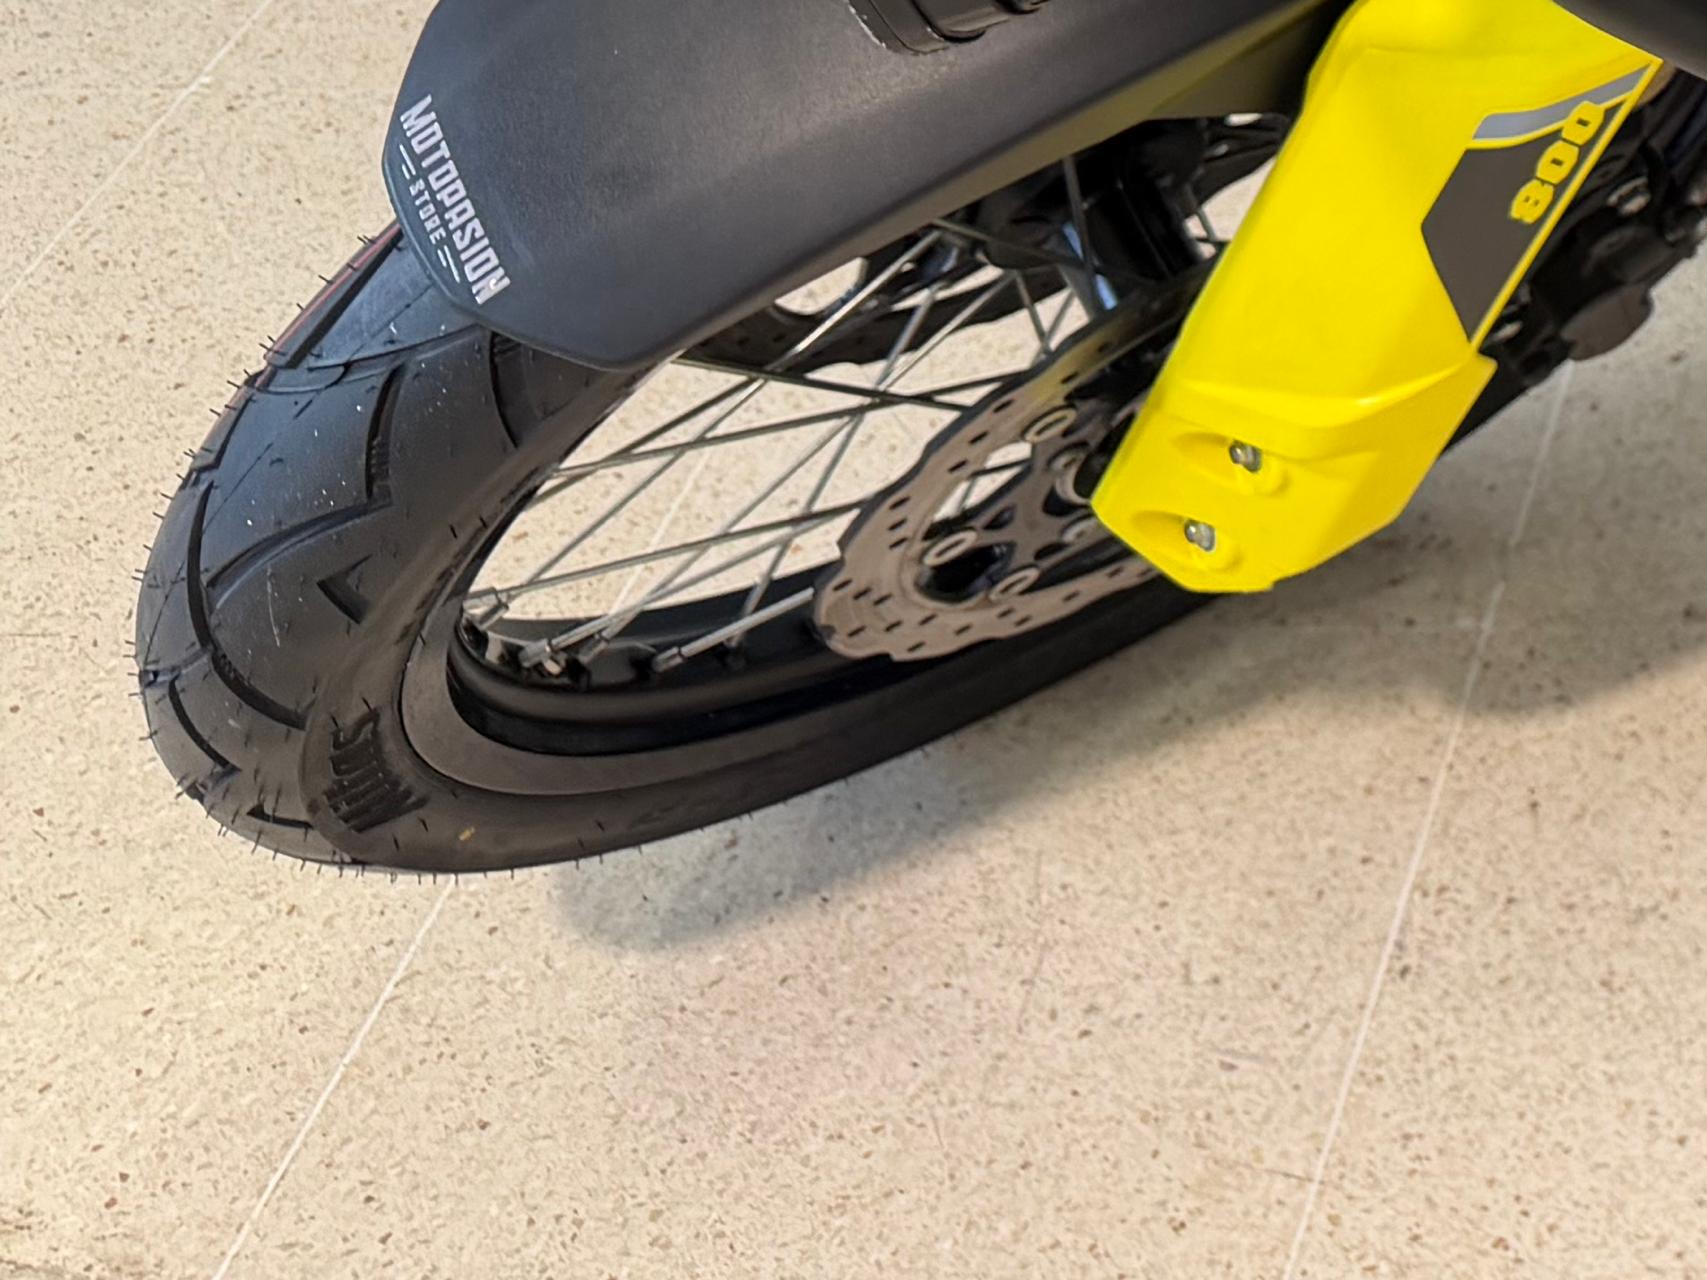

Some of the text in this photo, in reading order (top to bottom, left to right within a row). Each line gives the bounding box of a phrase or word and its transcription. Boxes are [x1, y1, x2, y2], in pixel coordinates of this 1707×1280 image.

[399, 93, 512, 306] MOTOPASION
[408, 178, 446, 246] STORE
[1508, 99, 1606, 227] 800
